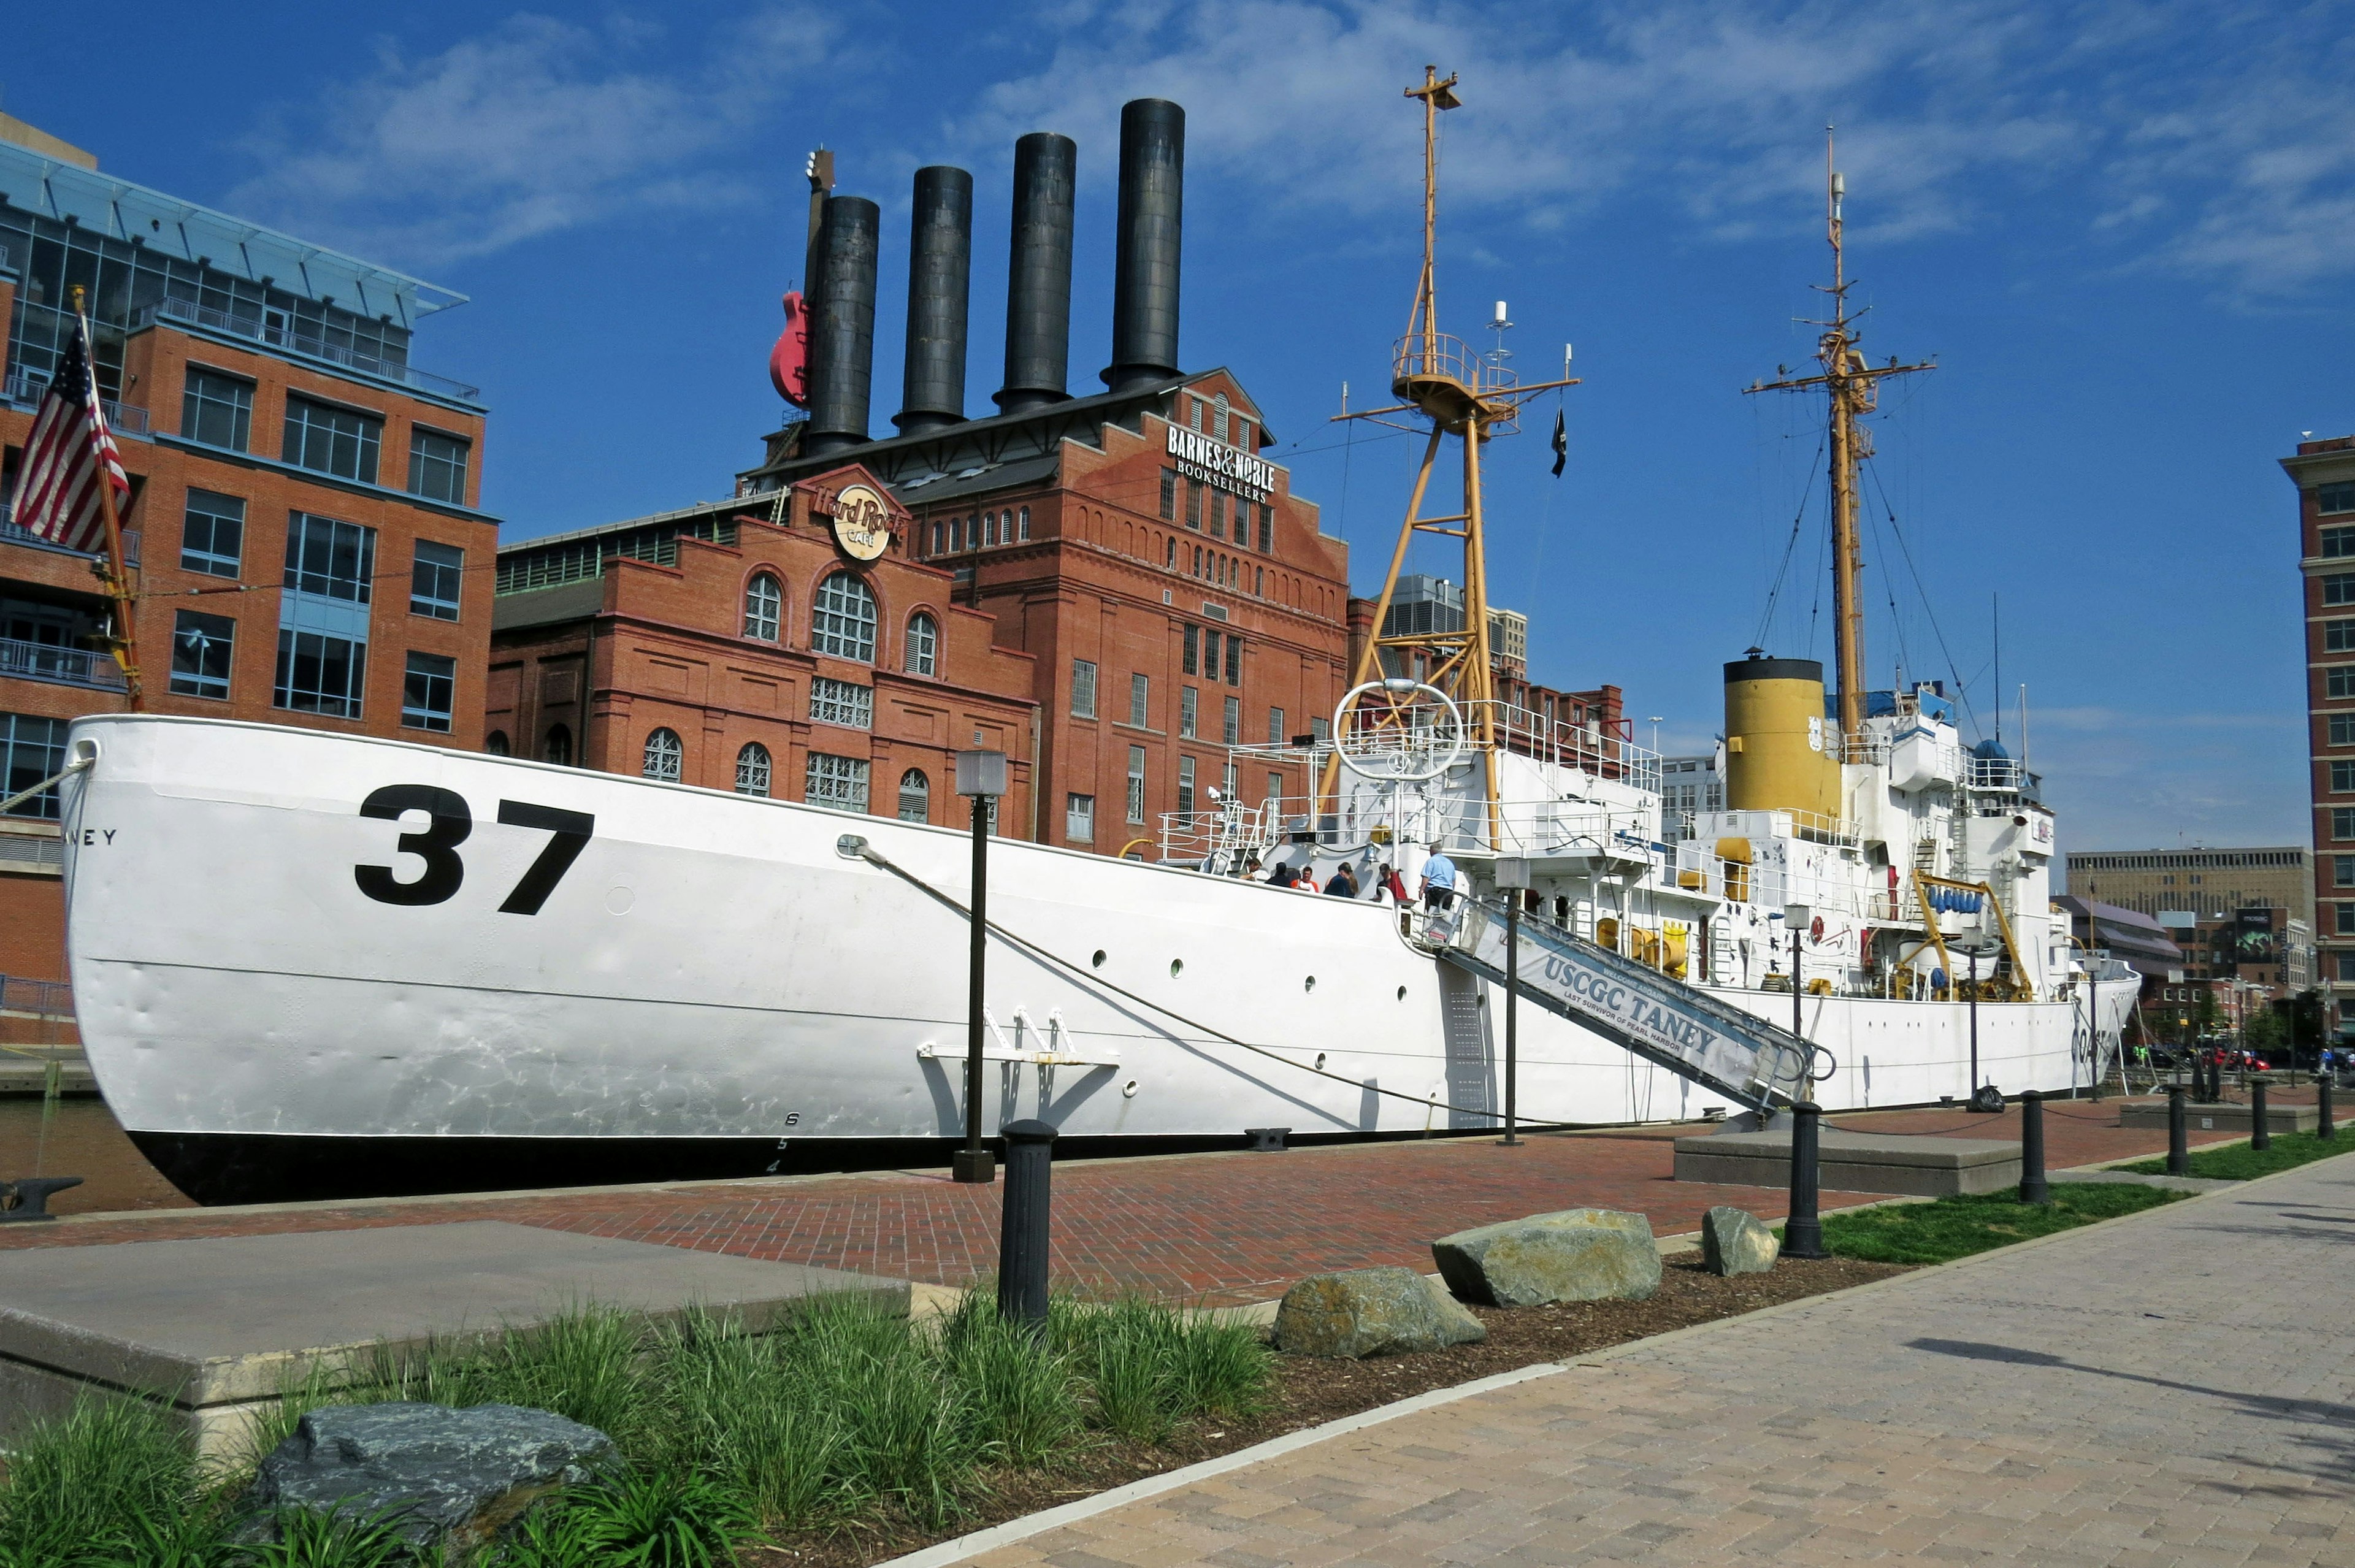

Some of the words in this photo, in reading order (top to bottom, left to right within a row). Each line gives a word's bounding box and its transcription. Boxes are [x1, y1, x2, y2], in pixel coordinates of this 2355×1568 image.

[1177, 460, 1266, 504] BOOKSELLERS
[813, 486, 862, 524] Hard
[861, 500, 905, 542] Rock
[847, 529, 875, 548] CAFE
[354, 784, 595, 916] 37
[1545, 955, 1625, 1011] USCGC
[1629, 996, 1717, 1055] TANEY
[1603, 968, 1638, 989] WELCOME
[1637, 985, 1666, 1003] ABOARD
[1564, 992, 1581, 1003] LAST
[1582, 1000, 1616, 1020] SURVIVOR
[1626, 1022, 1648, 1036] PEARL
[1650, 1033, 1680, 1052] HARBOR
[786, 1112, 800, 1125] 6
